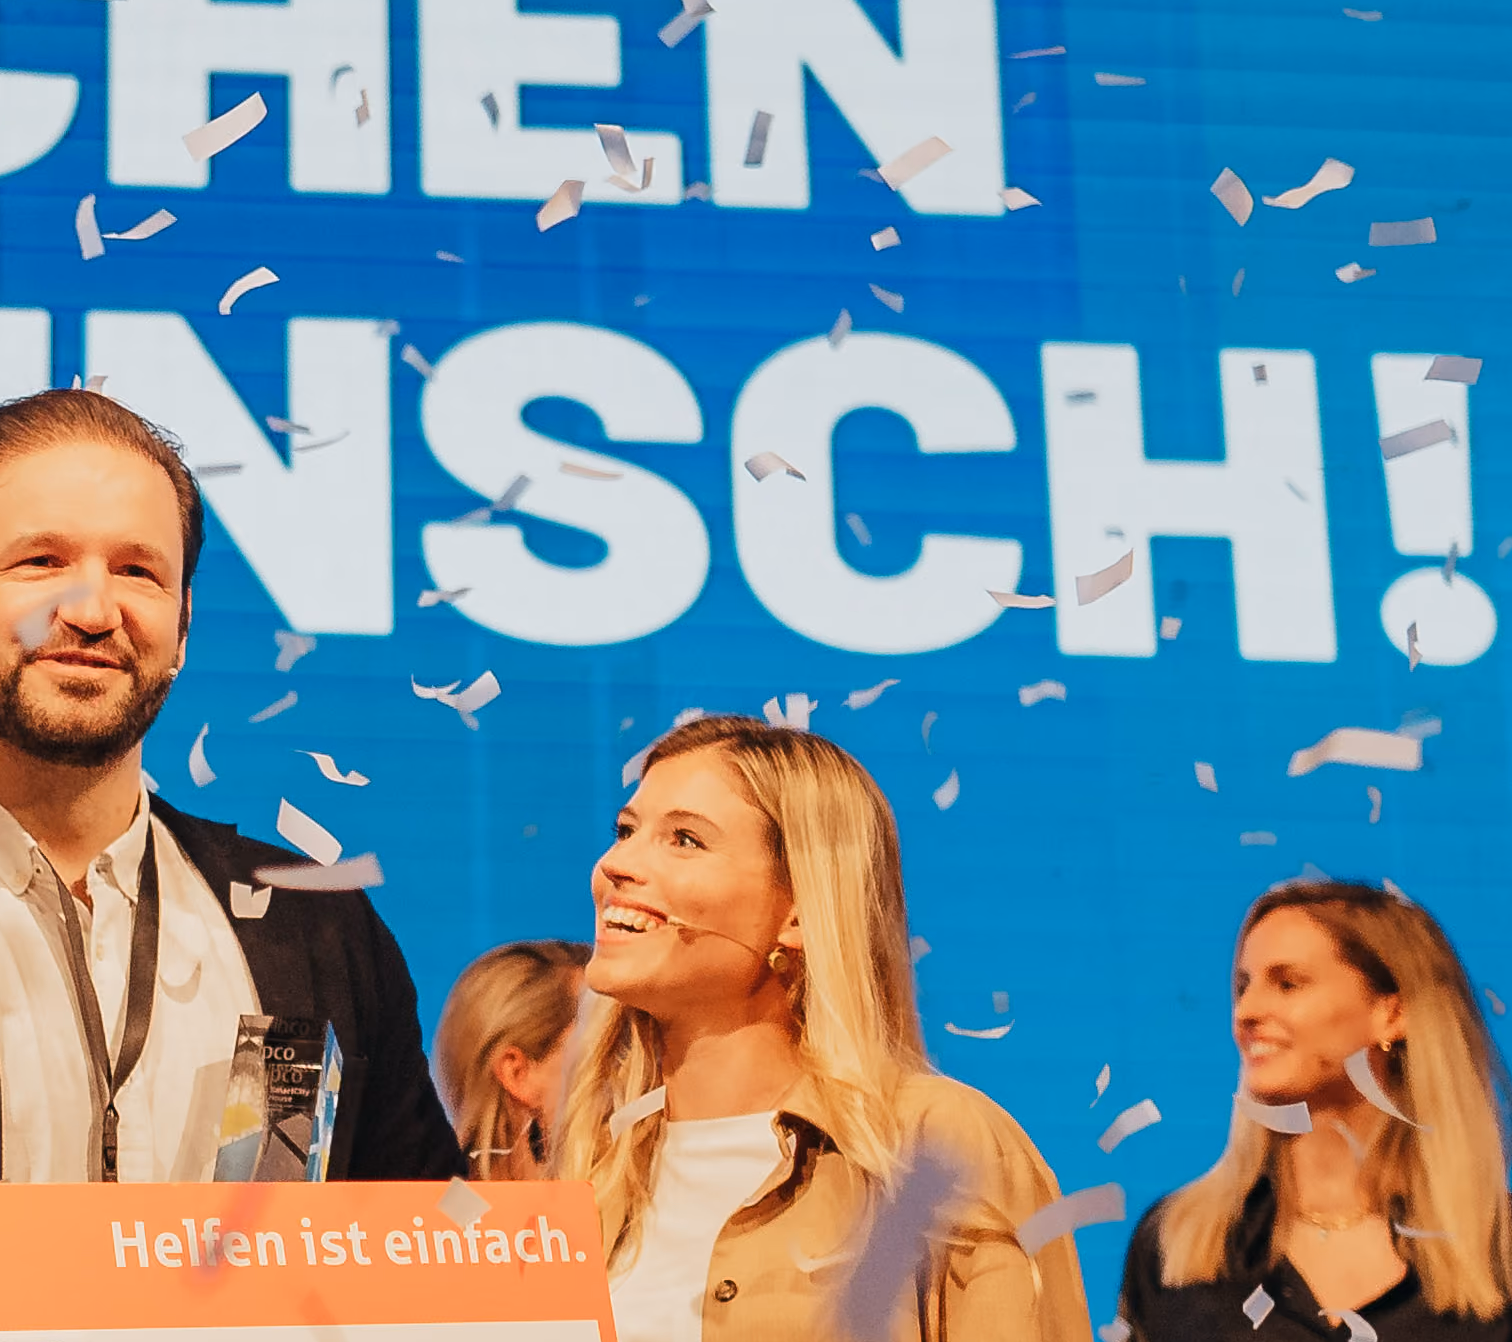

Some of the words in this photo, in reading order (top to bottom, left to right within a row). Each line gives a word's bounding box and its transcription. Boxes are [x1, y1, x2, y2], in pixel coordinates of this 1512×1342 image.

[111, 1216, 288, 1268] Helfen
[299, 1216, 372, 1266] ist
[383, 1215, 588, 1265] einfach.
